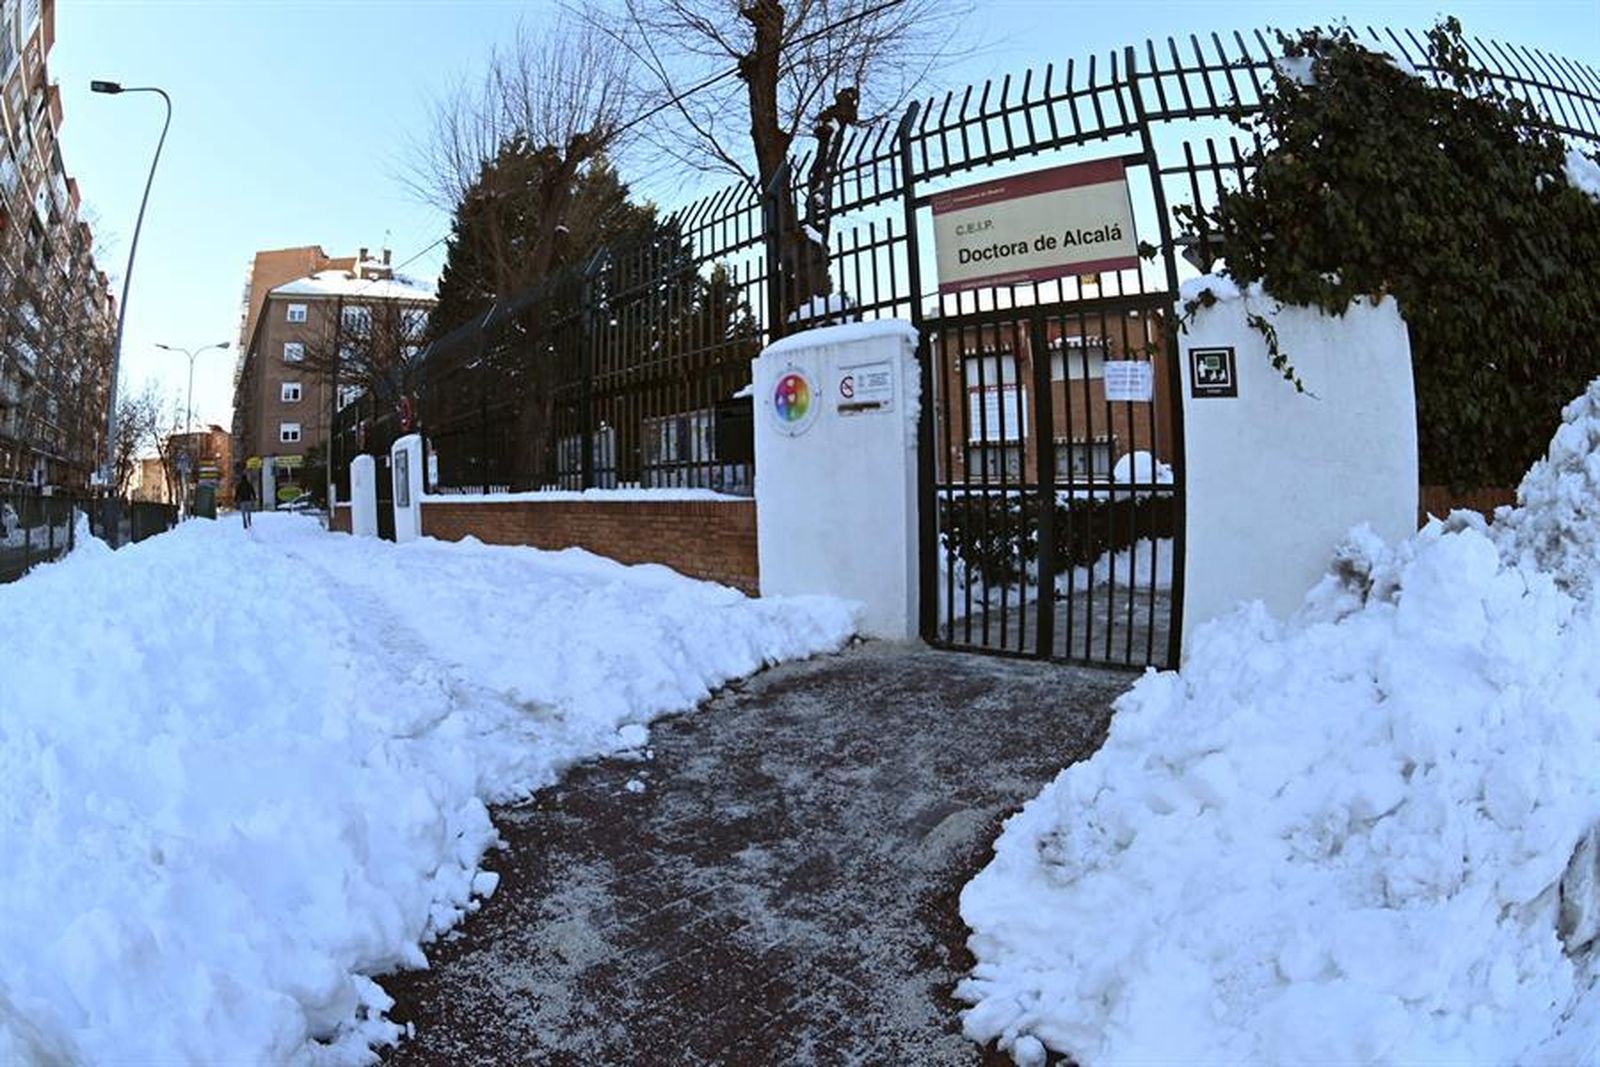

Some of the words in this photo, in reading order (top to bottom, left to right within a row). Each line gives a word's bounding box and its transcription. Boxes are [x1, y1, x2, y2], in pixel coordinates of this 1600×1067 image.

[955, 219, 994, 236] C.E.I.P.
[958, 241, 1028, 264] Doctora
[1033, 235, 1057, 251] de
[1063, 223, 1122, 247] Alcalá
